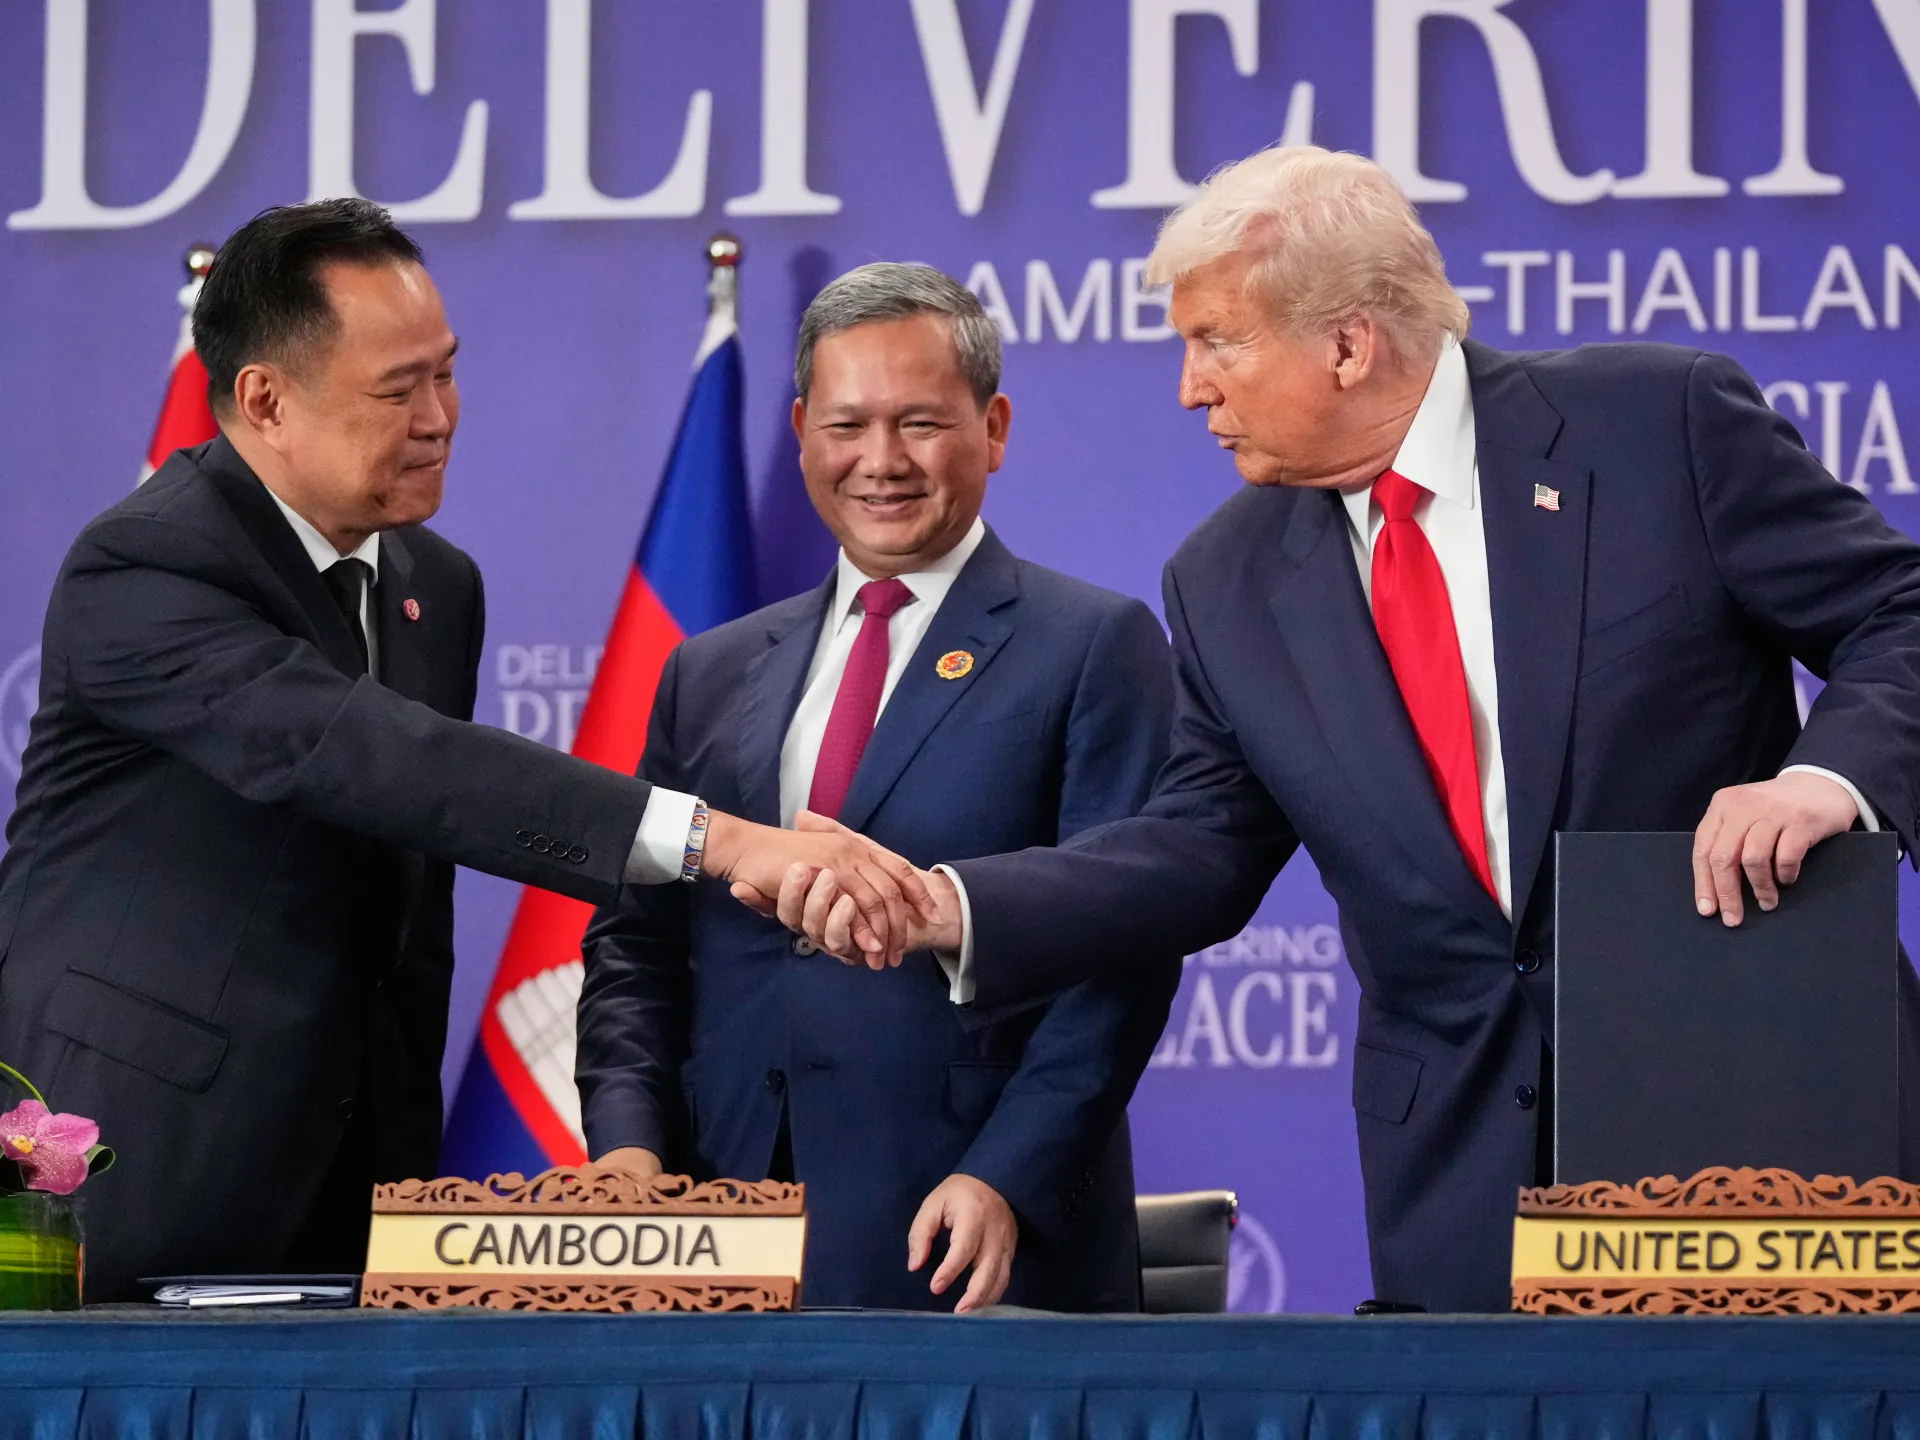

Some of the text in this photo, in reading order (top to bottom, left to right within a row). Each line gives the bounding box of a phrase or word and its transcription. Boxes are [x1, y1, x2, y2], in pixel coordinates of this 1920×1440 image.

[434, 1222, 720, 1267] CAMBODIA
[1556, 1229, 1920, 1272] UNITED STATES
